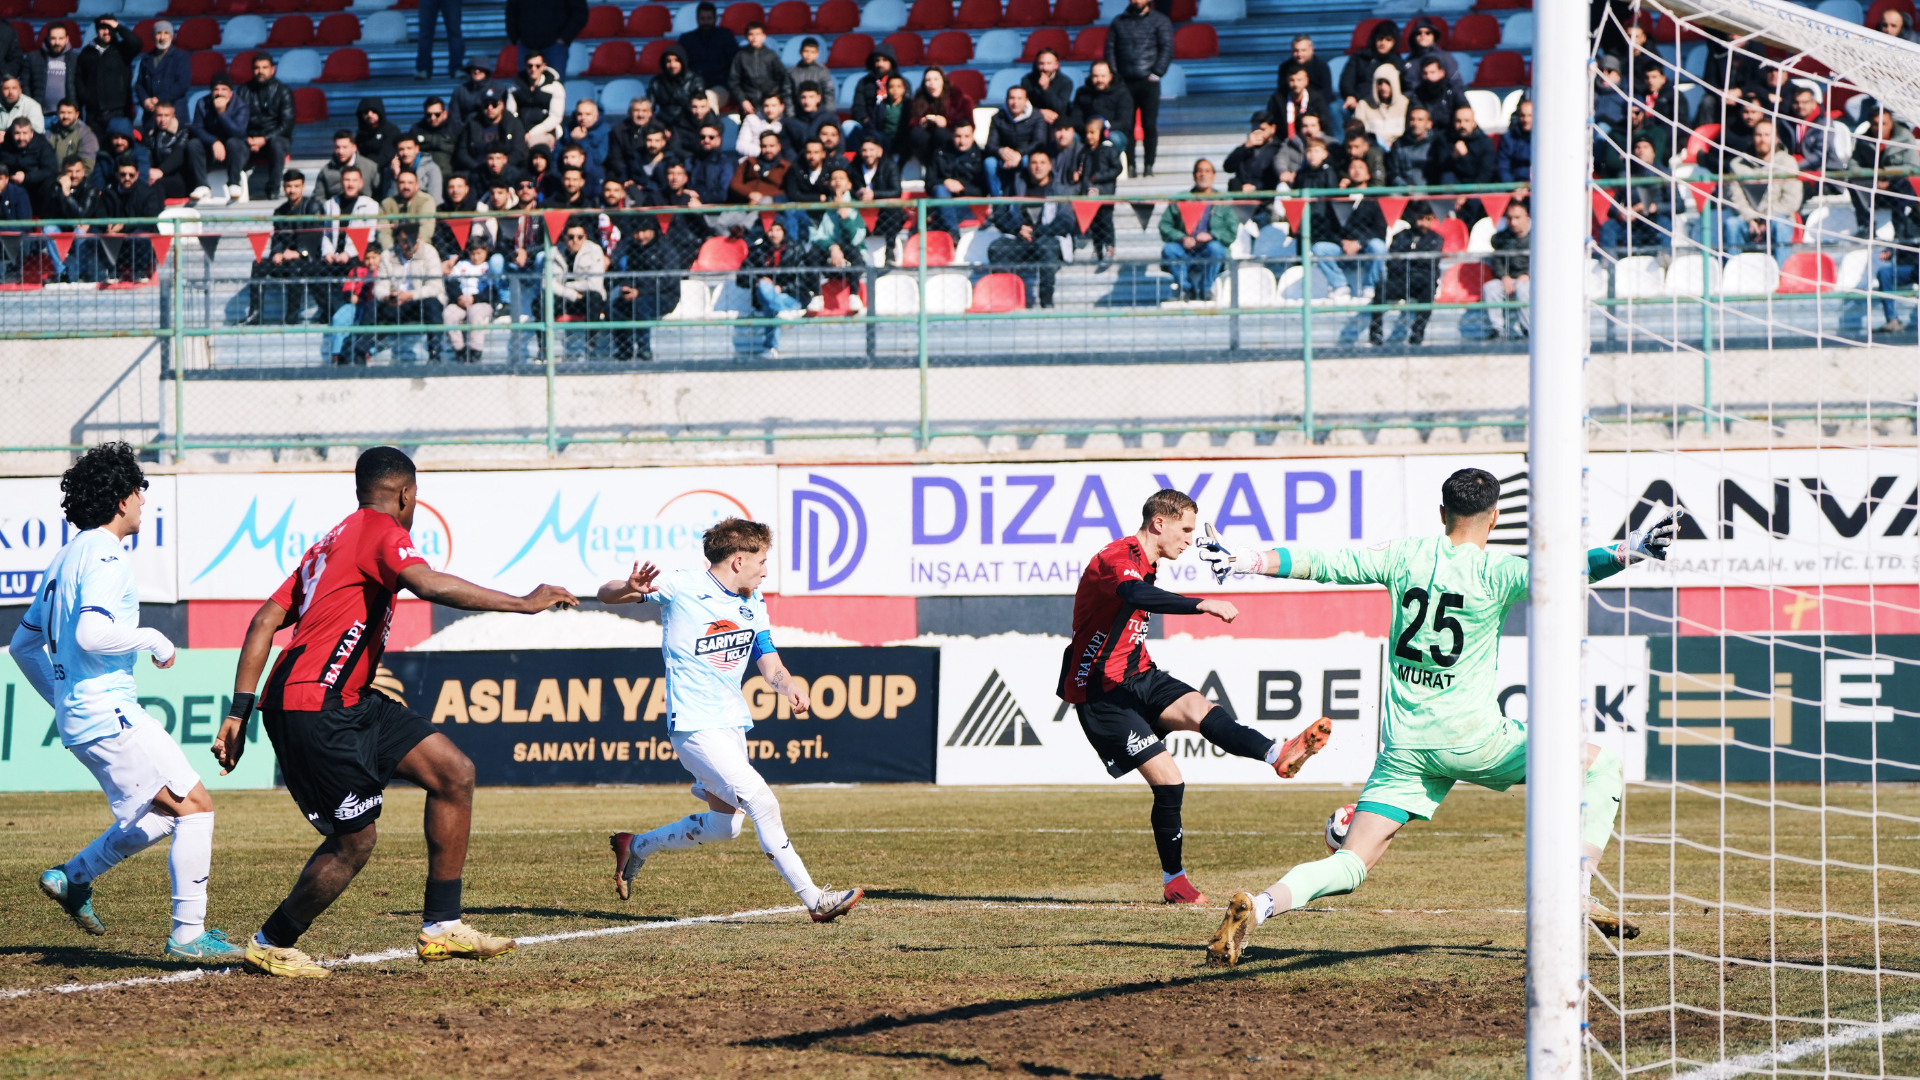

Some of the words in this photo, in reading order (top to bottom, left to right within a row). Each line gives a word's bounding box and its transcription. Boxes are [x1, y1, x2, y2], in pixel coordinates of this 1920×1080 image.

[911, 557, 1003, 589] İNŞAAT
[1170, 565, 1196, 580] ve
[336, 619, 367, 659] YAPI
[697, 630, 752, 653] SARIYER
[1395, 587, 1464, 668] 25
[726, 647, 748, 662] KOLA
[1083, 630, 1107, 658] YAPI
[1397, 664, 1455, 690] MURAT
[431, 678, 603, 724] ASLAN
[741, 673, 917, 721] GROUP
[513, 736, 596, 763] SANAYİ
[601, 741, 630, 761] VE
[786, 734, 830, 765] ŞTİ.
